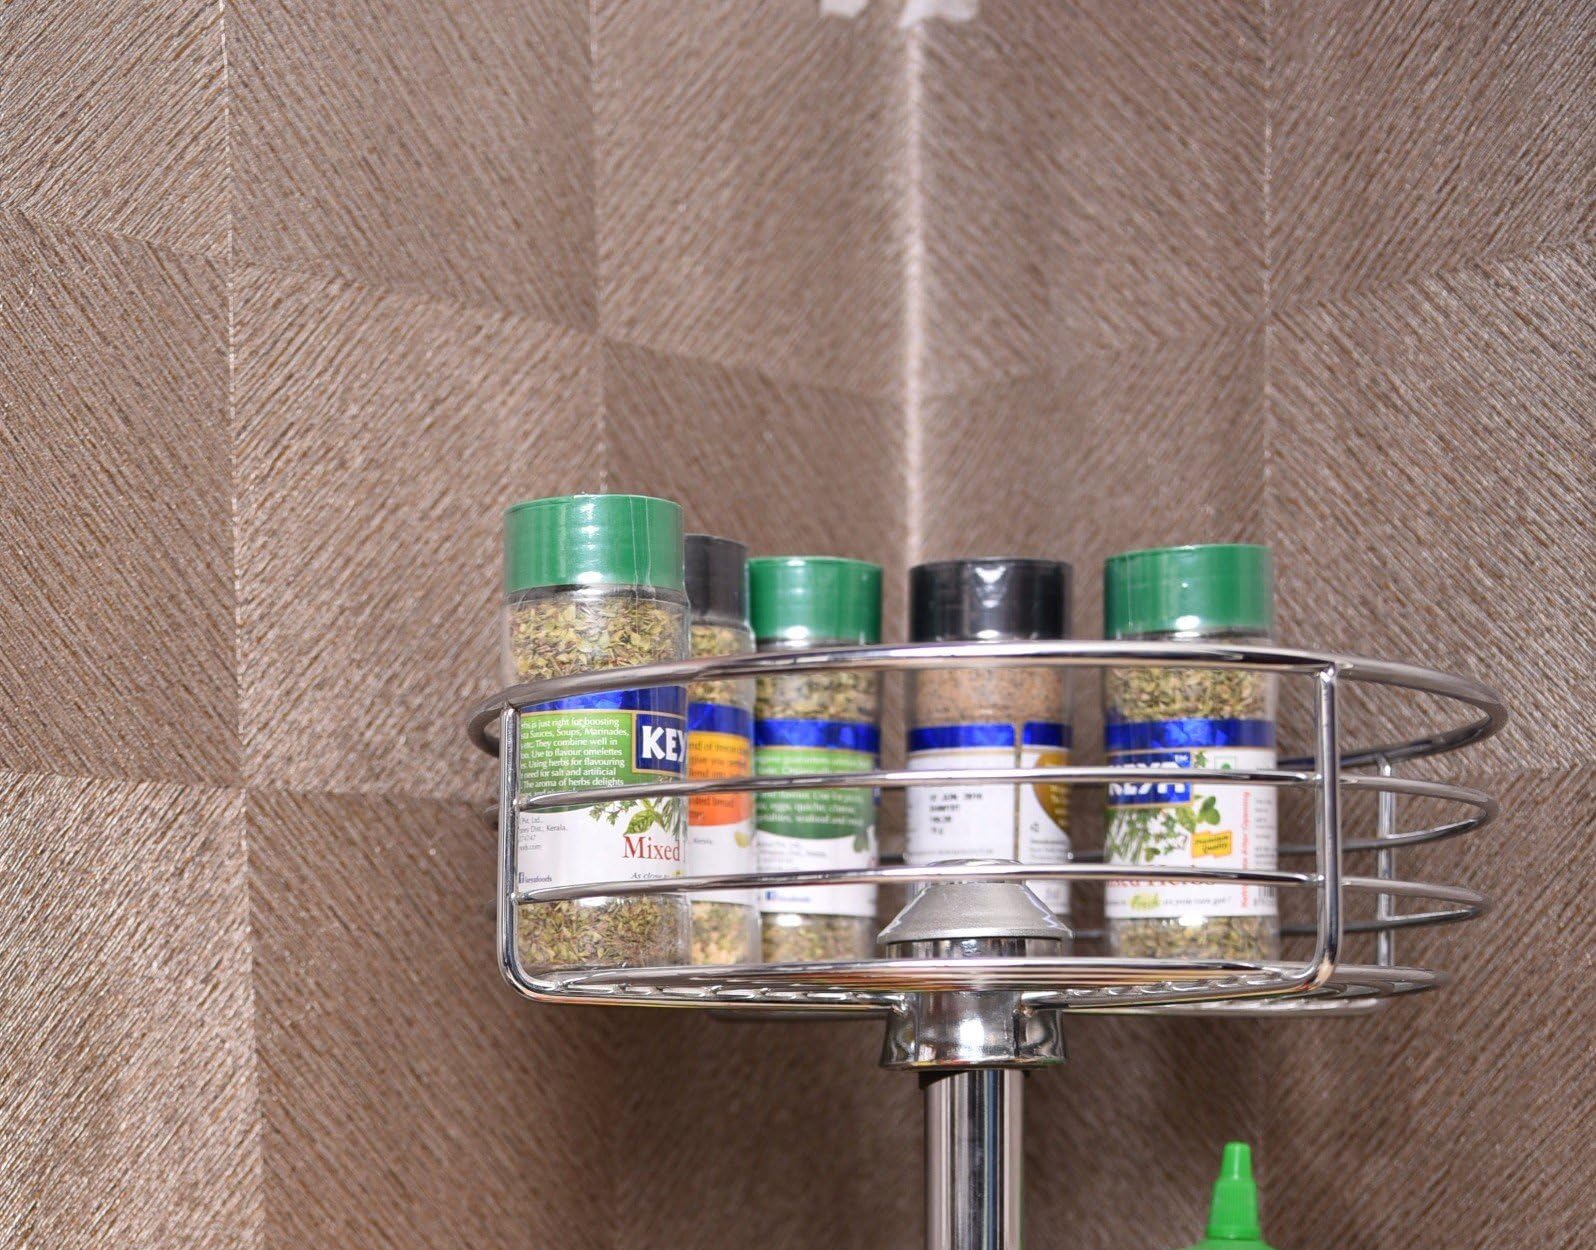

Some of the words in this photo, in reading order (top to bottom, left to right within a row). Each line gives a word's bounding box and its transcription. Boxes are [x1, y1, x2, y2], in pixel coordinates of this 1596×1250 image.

[538, 719, 551, 729] just
[552, 716, 570, 729] right
[584, 716, 620, 729] boosting
[556, 728, 582, 738] Soups,
[553, 738, 588, 747] combine
[590, 737, 608, 746] well
[554, 748, 581, 757] flavour
[548, 758, 570, 767] herbs
[571, 758, 582, 766] for
[584, 758, 625, 768] flavouring
[551, 768, 565, 776] salt
[566, 768, 582, 776] and
[582, 768, 616, 776] artificial
[568, 778, 591, 786] herbs
[592, 778, 624, 787] delights
[623, 835, 681, 862] Mixed
